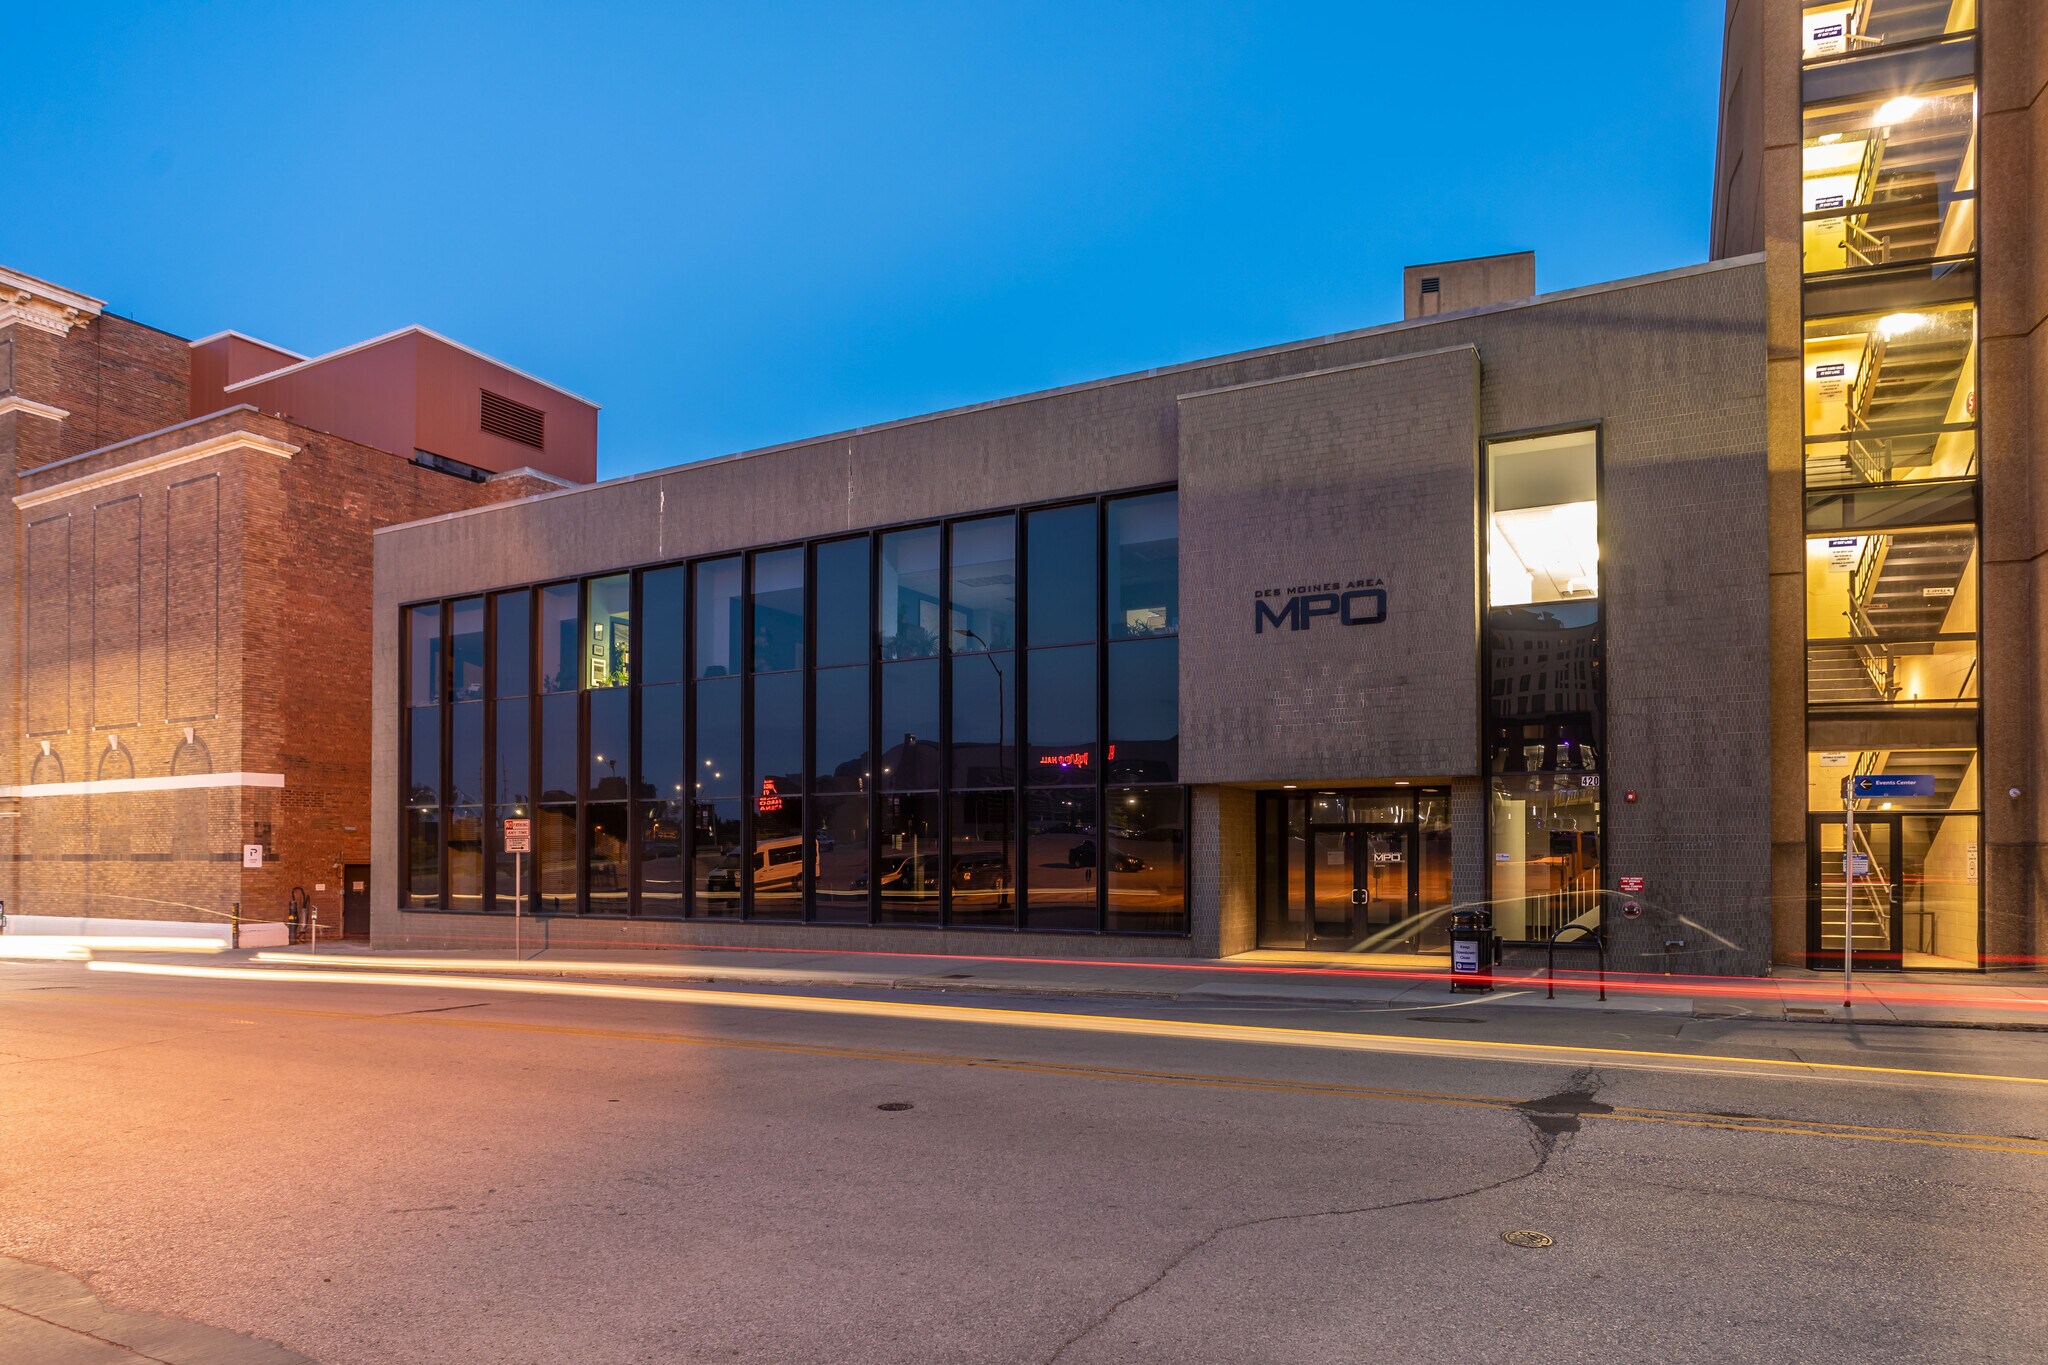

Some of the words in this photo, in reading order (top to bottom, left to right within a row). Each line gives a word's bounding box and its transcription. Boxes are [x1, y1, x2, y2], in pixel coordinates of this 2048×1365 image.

[1255, 588, 1281, 598] DES
[1287, 582, 1340, 595] MOINES
[1346, 578, 1384, 588] AREA
[1255, 588, 1387, 634] MPO
[1582, 776, 1599, 786] 420
[1374, 853, 1400, 861] MPO
